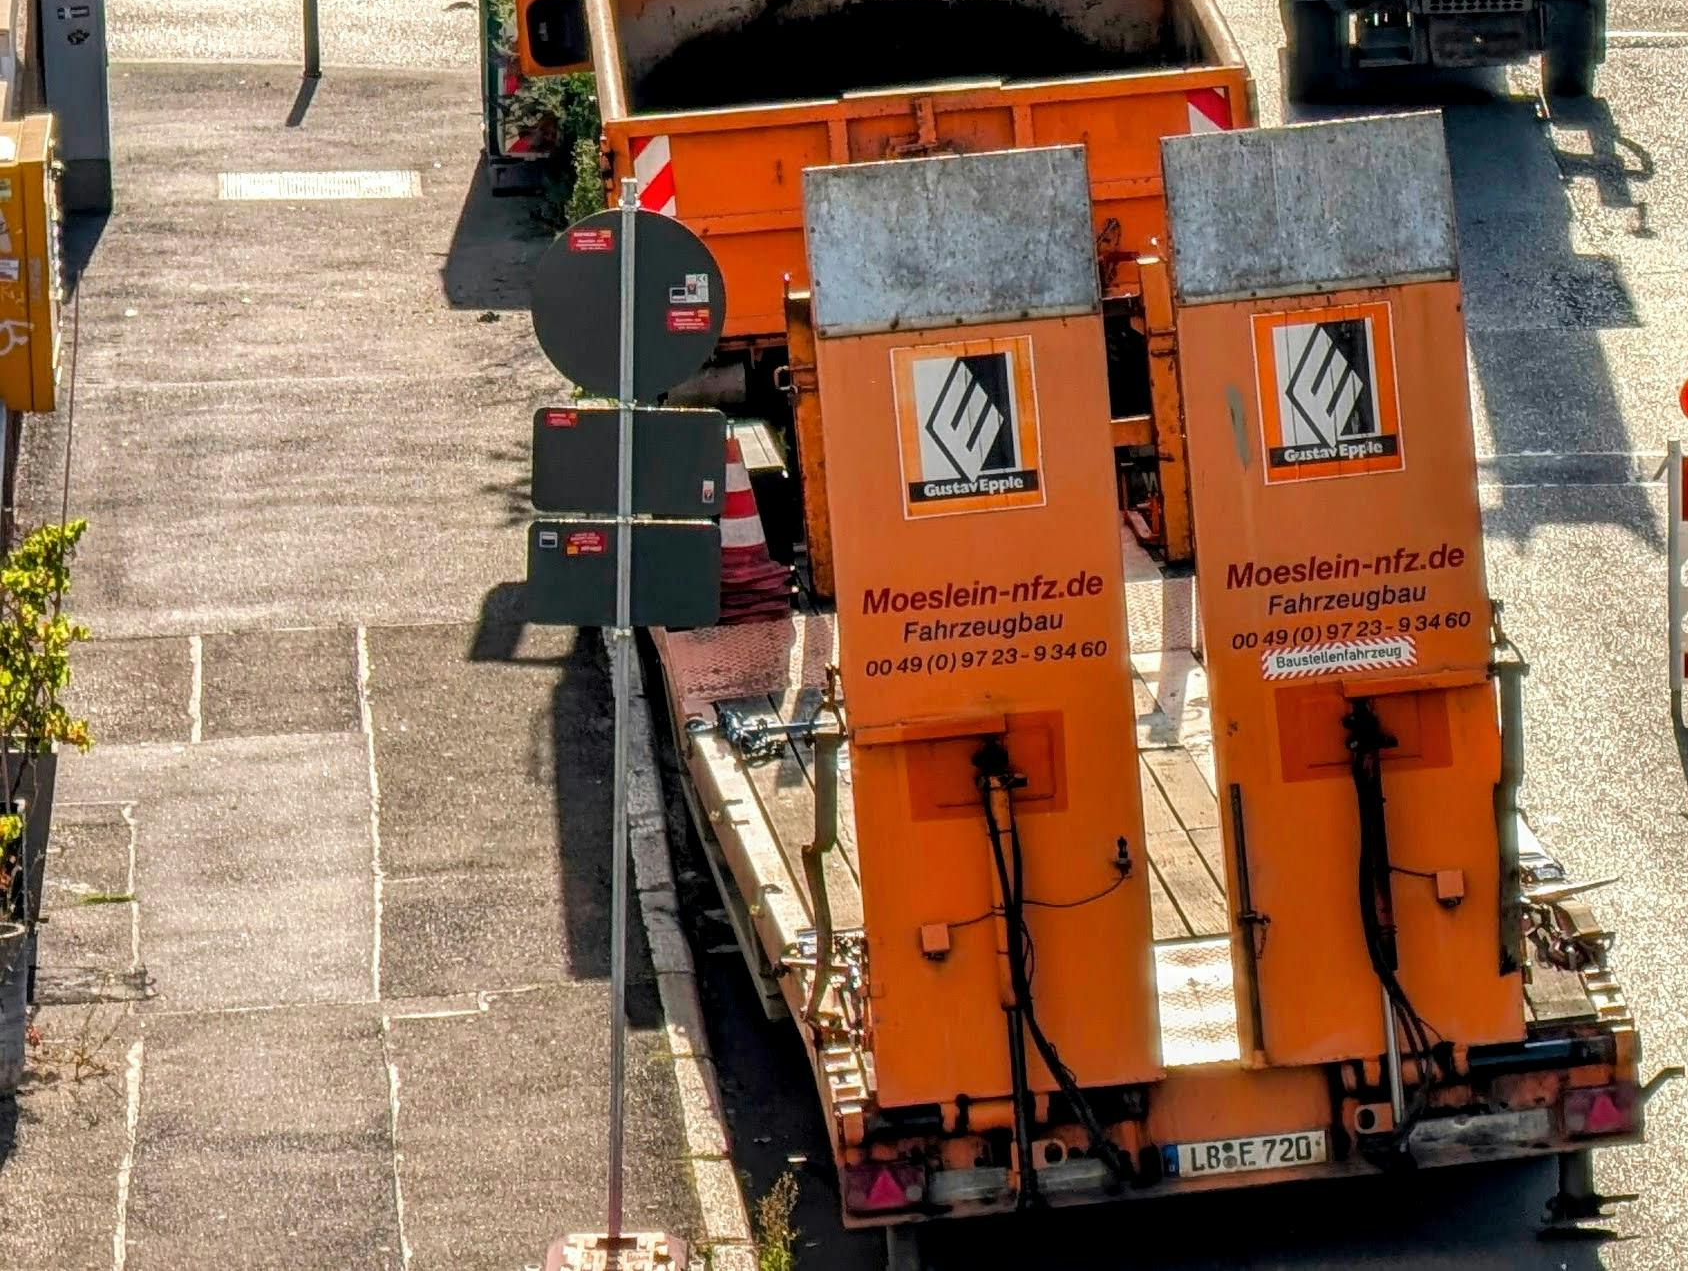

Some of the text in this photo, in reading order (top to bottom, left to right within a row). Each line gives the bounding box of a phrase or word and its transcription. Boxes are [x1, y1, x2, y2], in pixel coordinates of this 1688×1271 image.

[1225, 542, 1466, 590] Moeslein-nfz.de
[862, 570, 1104, 615] Moeslein-nfz.de
[1268, 584, 1427, 616] Fahrzeugbau
[903, 611, 1064, 644] Fahrzeugbau
[1275, 645, 1403, 670] Baustellenfahrzeug
[1190, 1144, 1222, 1172] LB
[1262, 1135, 1312, 1163] 720
